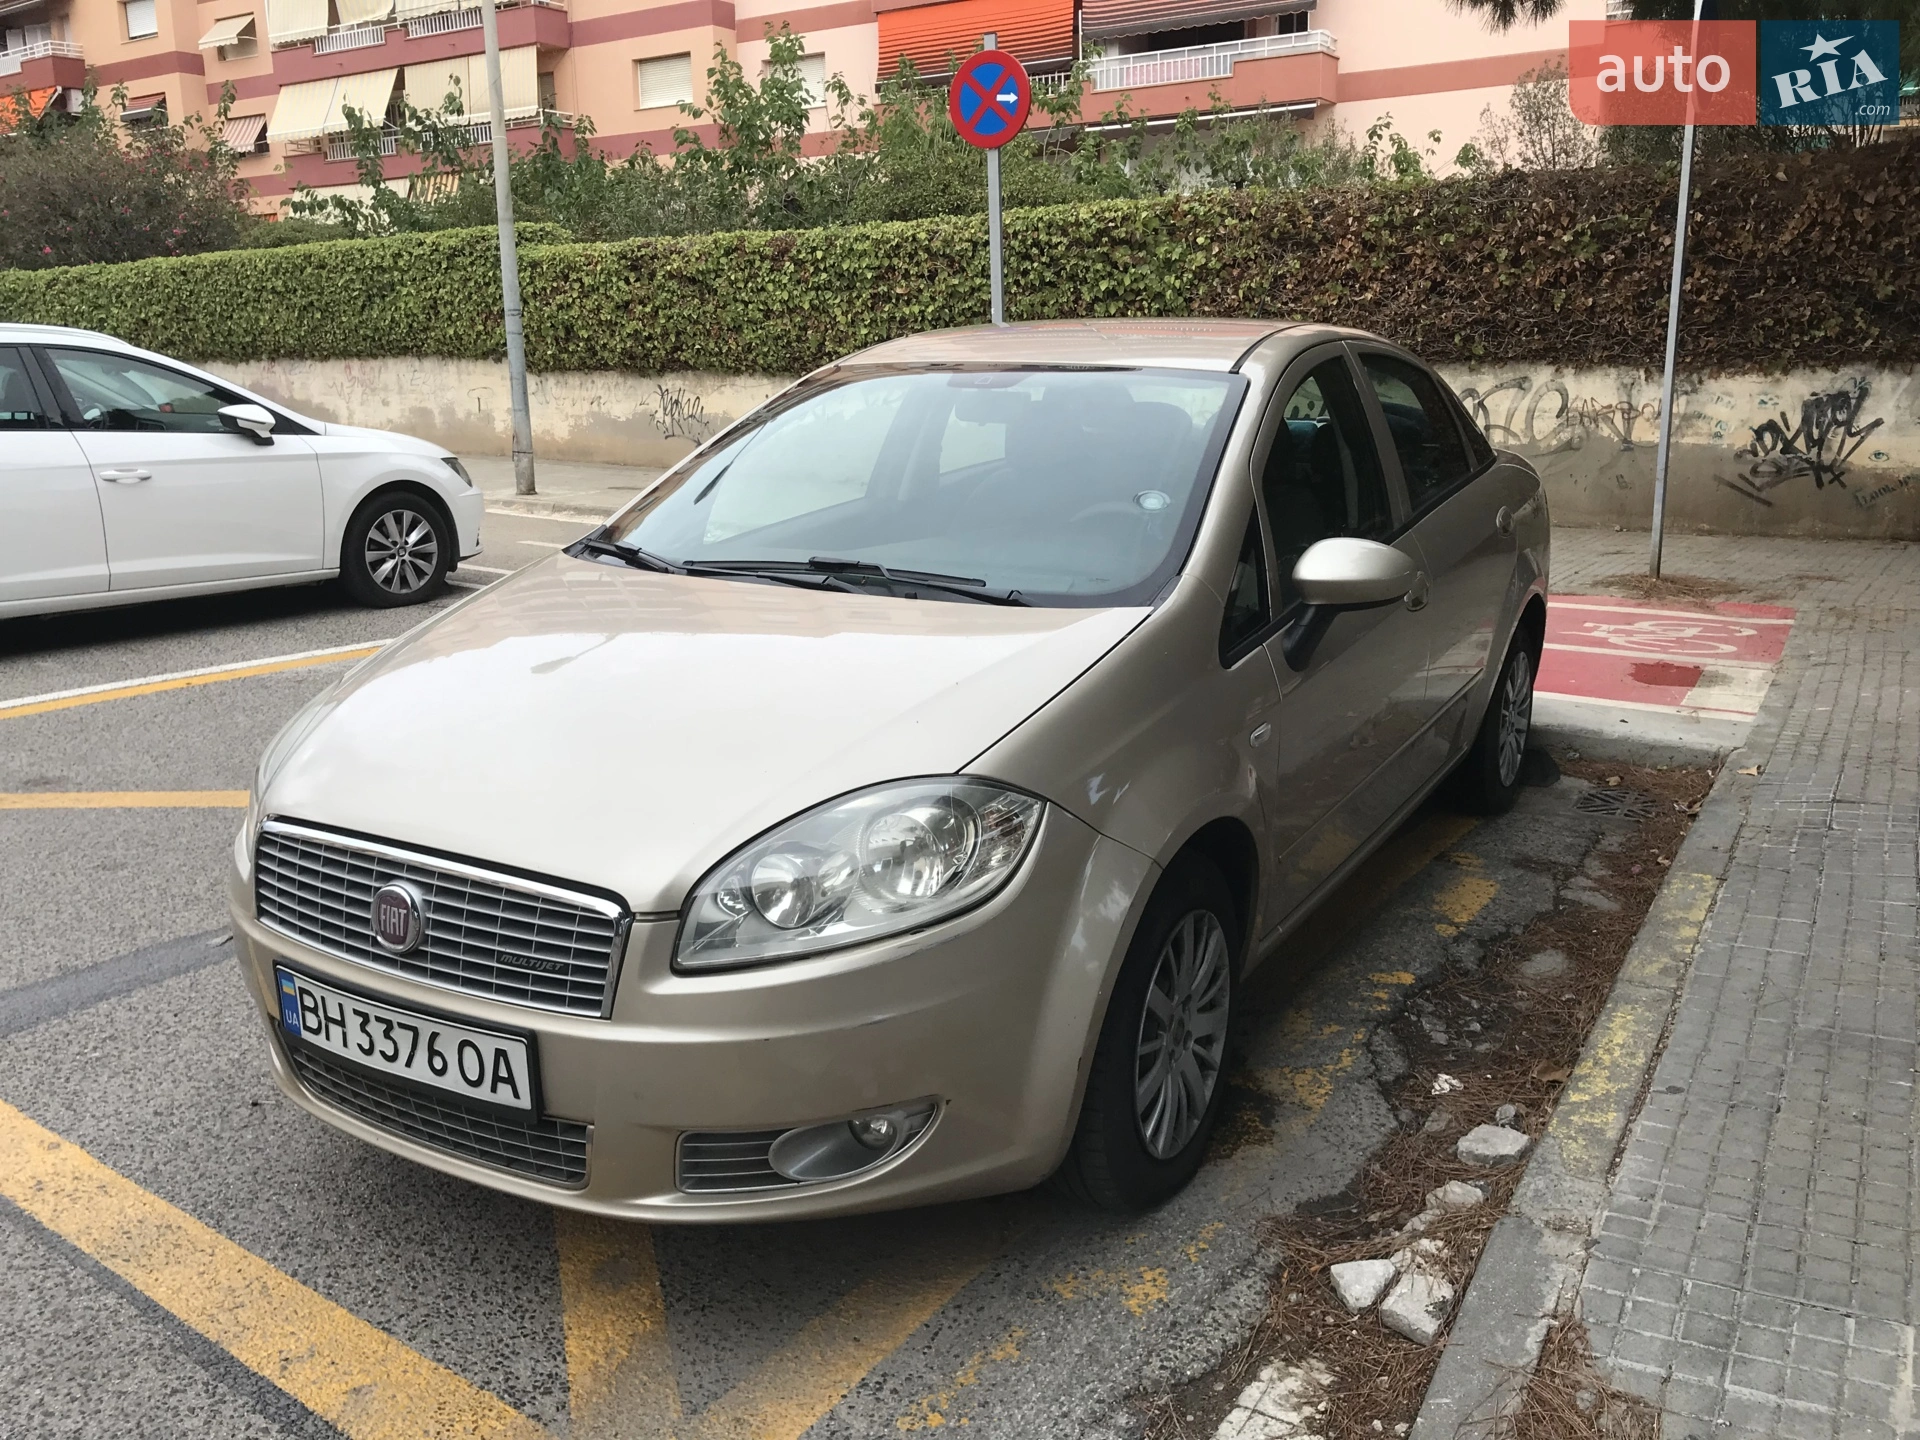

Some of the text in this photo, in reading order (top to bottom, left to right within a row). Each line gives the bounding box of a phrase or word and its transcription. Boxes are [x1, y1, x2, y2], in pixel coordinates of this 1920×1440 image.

[380, 903, 408, 937] FIAT
[500, 954, 564, 971] MULTIJET
[285, 1008, 300, 1028] UA
